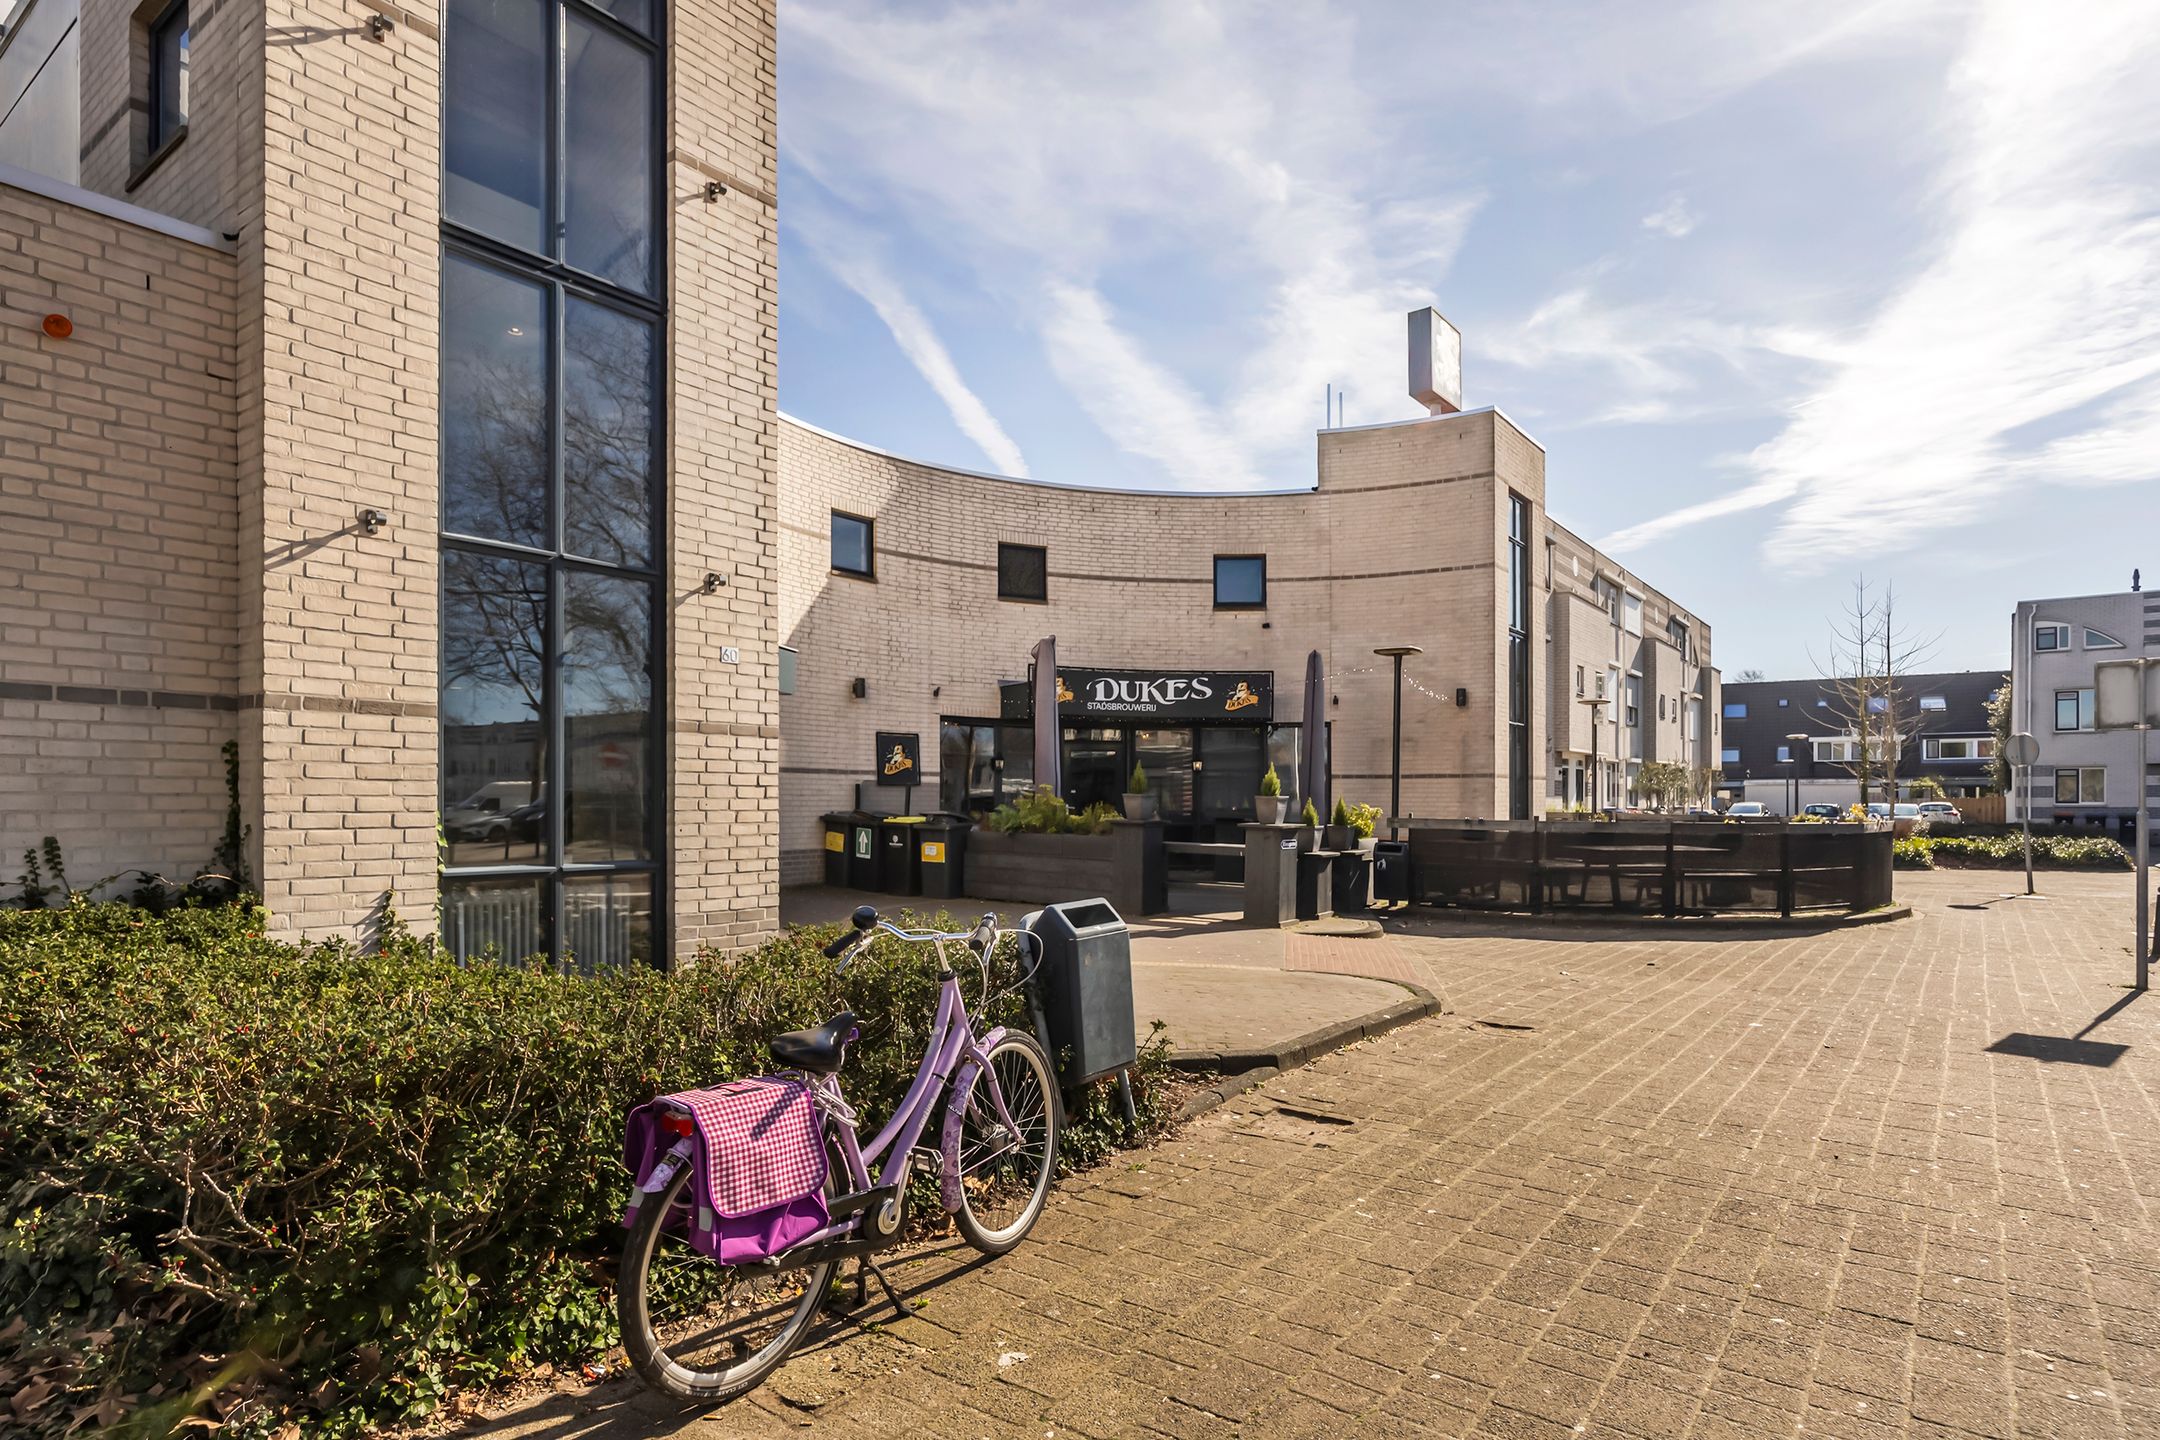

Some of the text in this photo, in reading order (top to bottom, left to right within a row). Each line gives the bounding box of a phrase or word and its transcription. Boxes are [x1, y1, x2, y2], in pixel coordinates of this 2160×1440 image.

[722, 648, 738, 662] 60
[1086, 677, 1213, 705] DUKES
[1086, 701, 1157, 712] STADSBROUWERIJ
